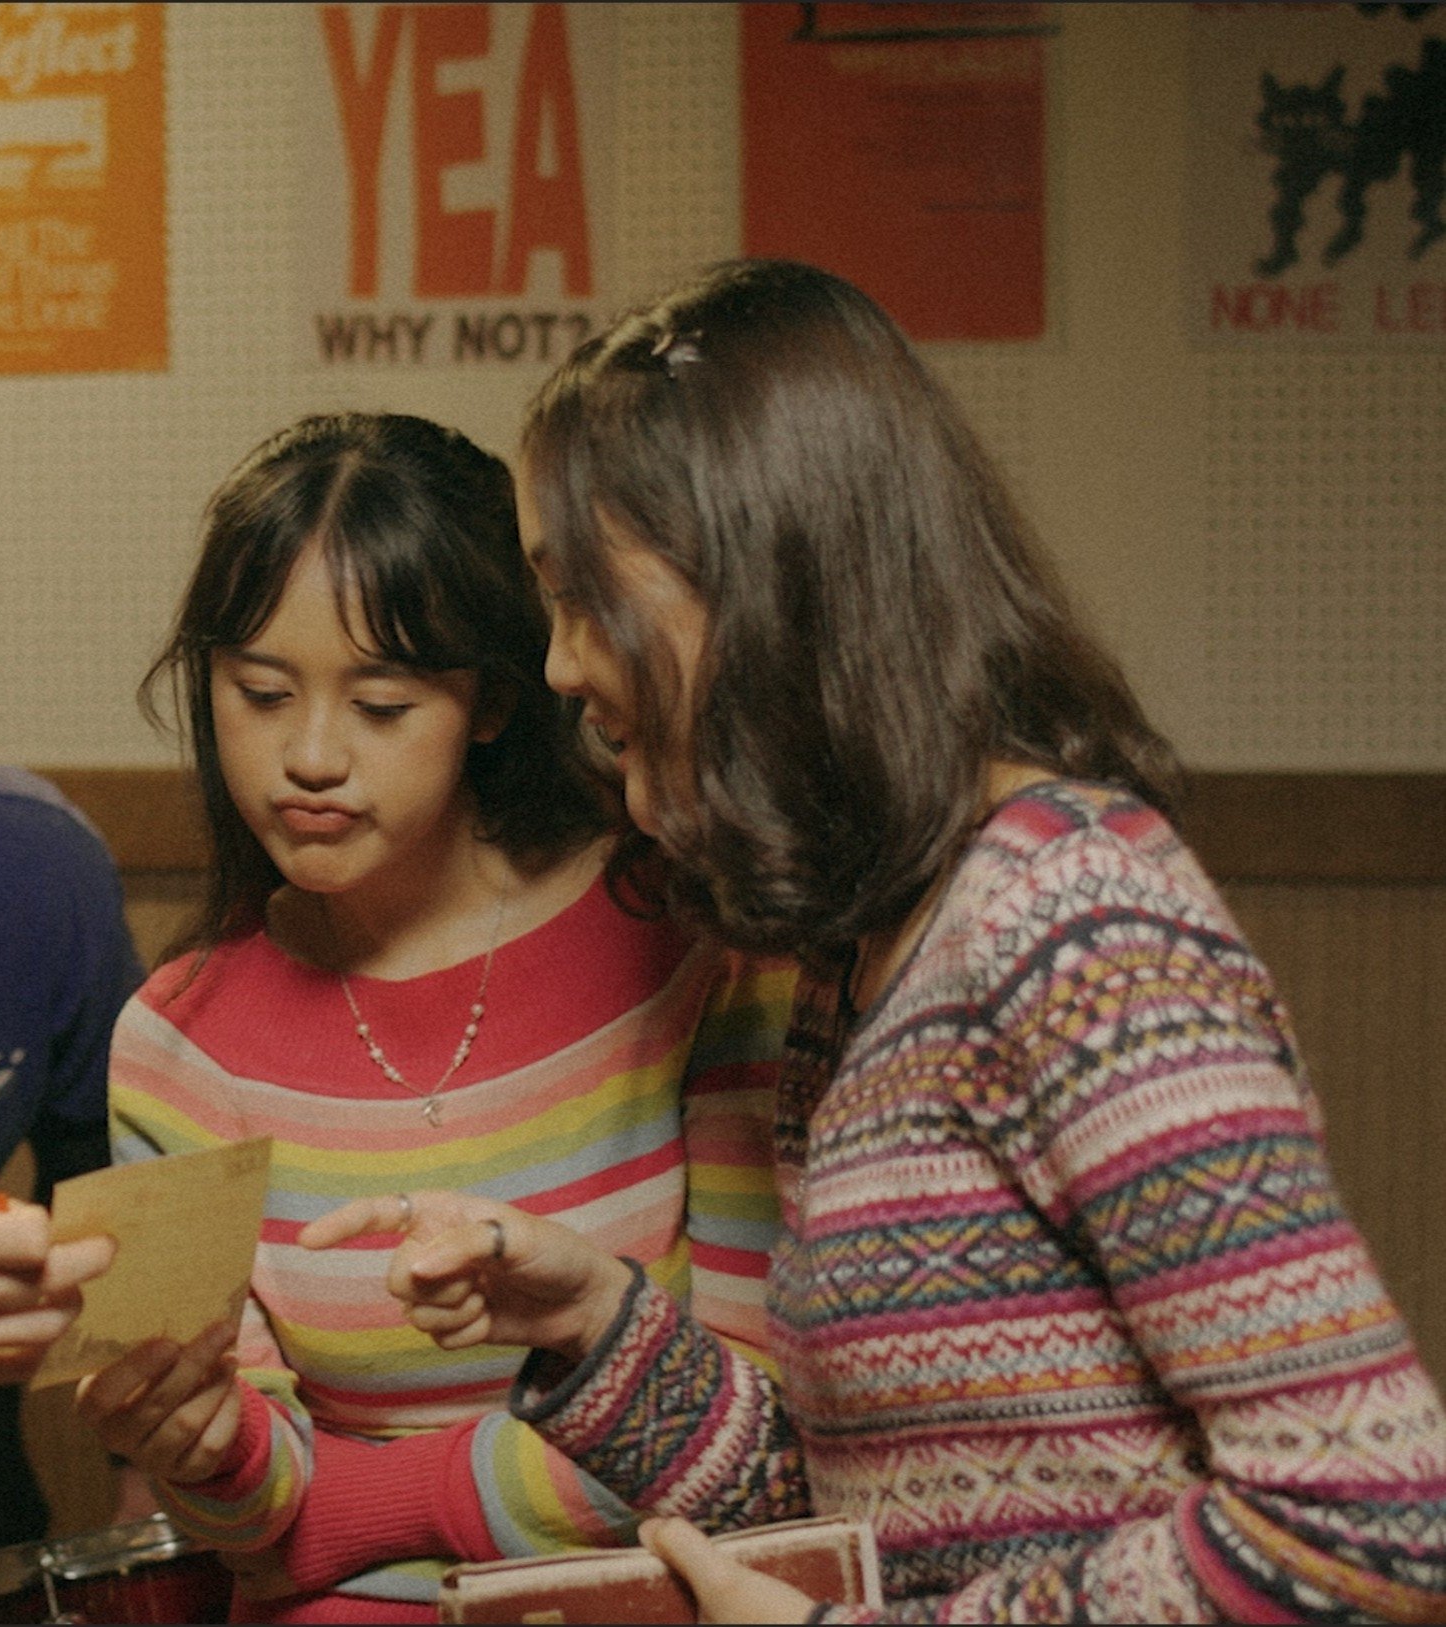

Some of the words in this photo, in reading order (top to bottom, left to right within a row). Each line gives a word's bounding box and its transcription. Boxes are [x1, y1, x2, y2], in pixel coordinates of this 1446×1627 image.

[318, 3, 596, 299] YEA
[1210, 283, 1342, 335] NONE
[314, 312, 435, 364] WHY
